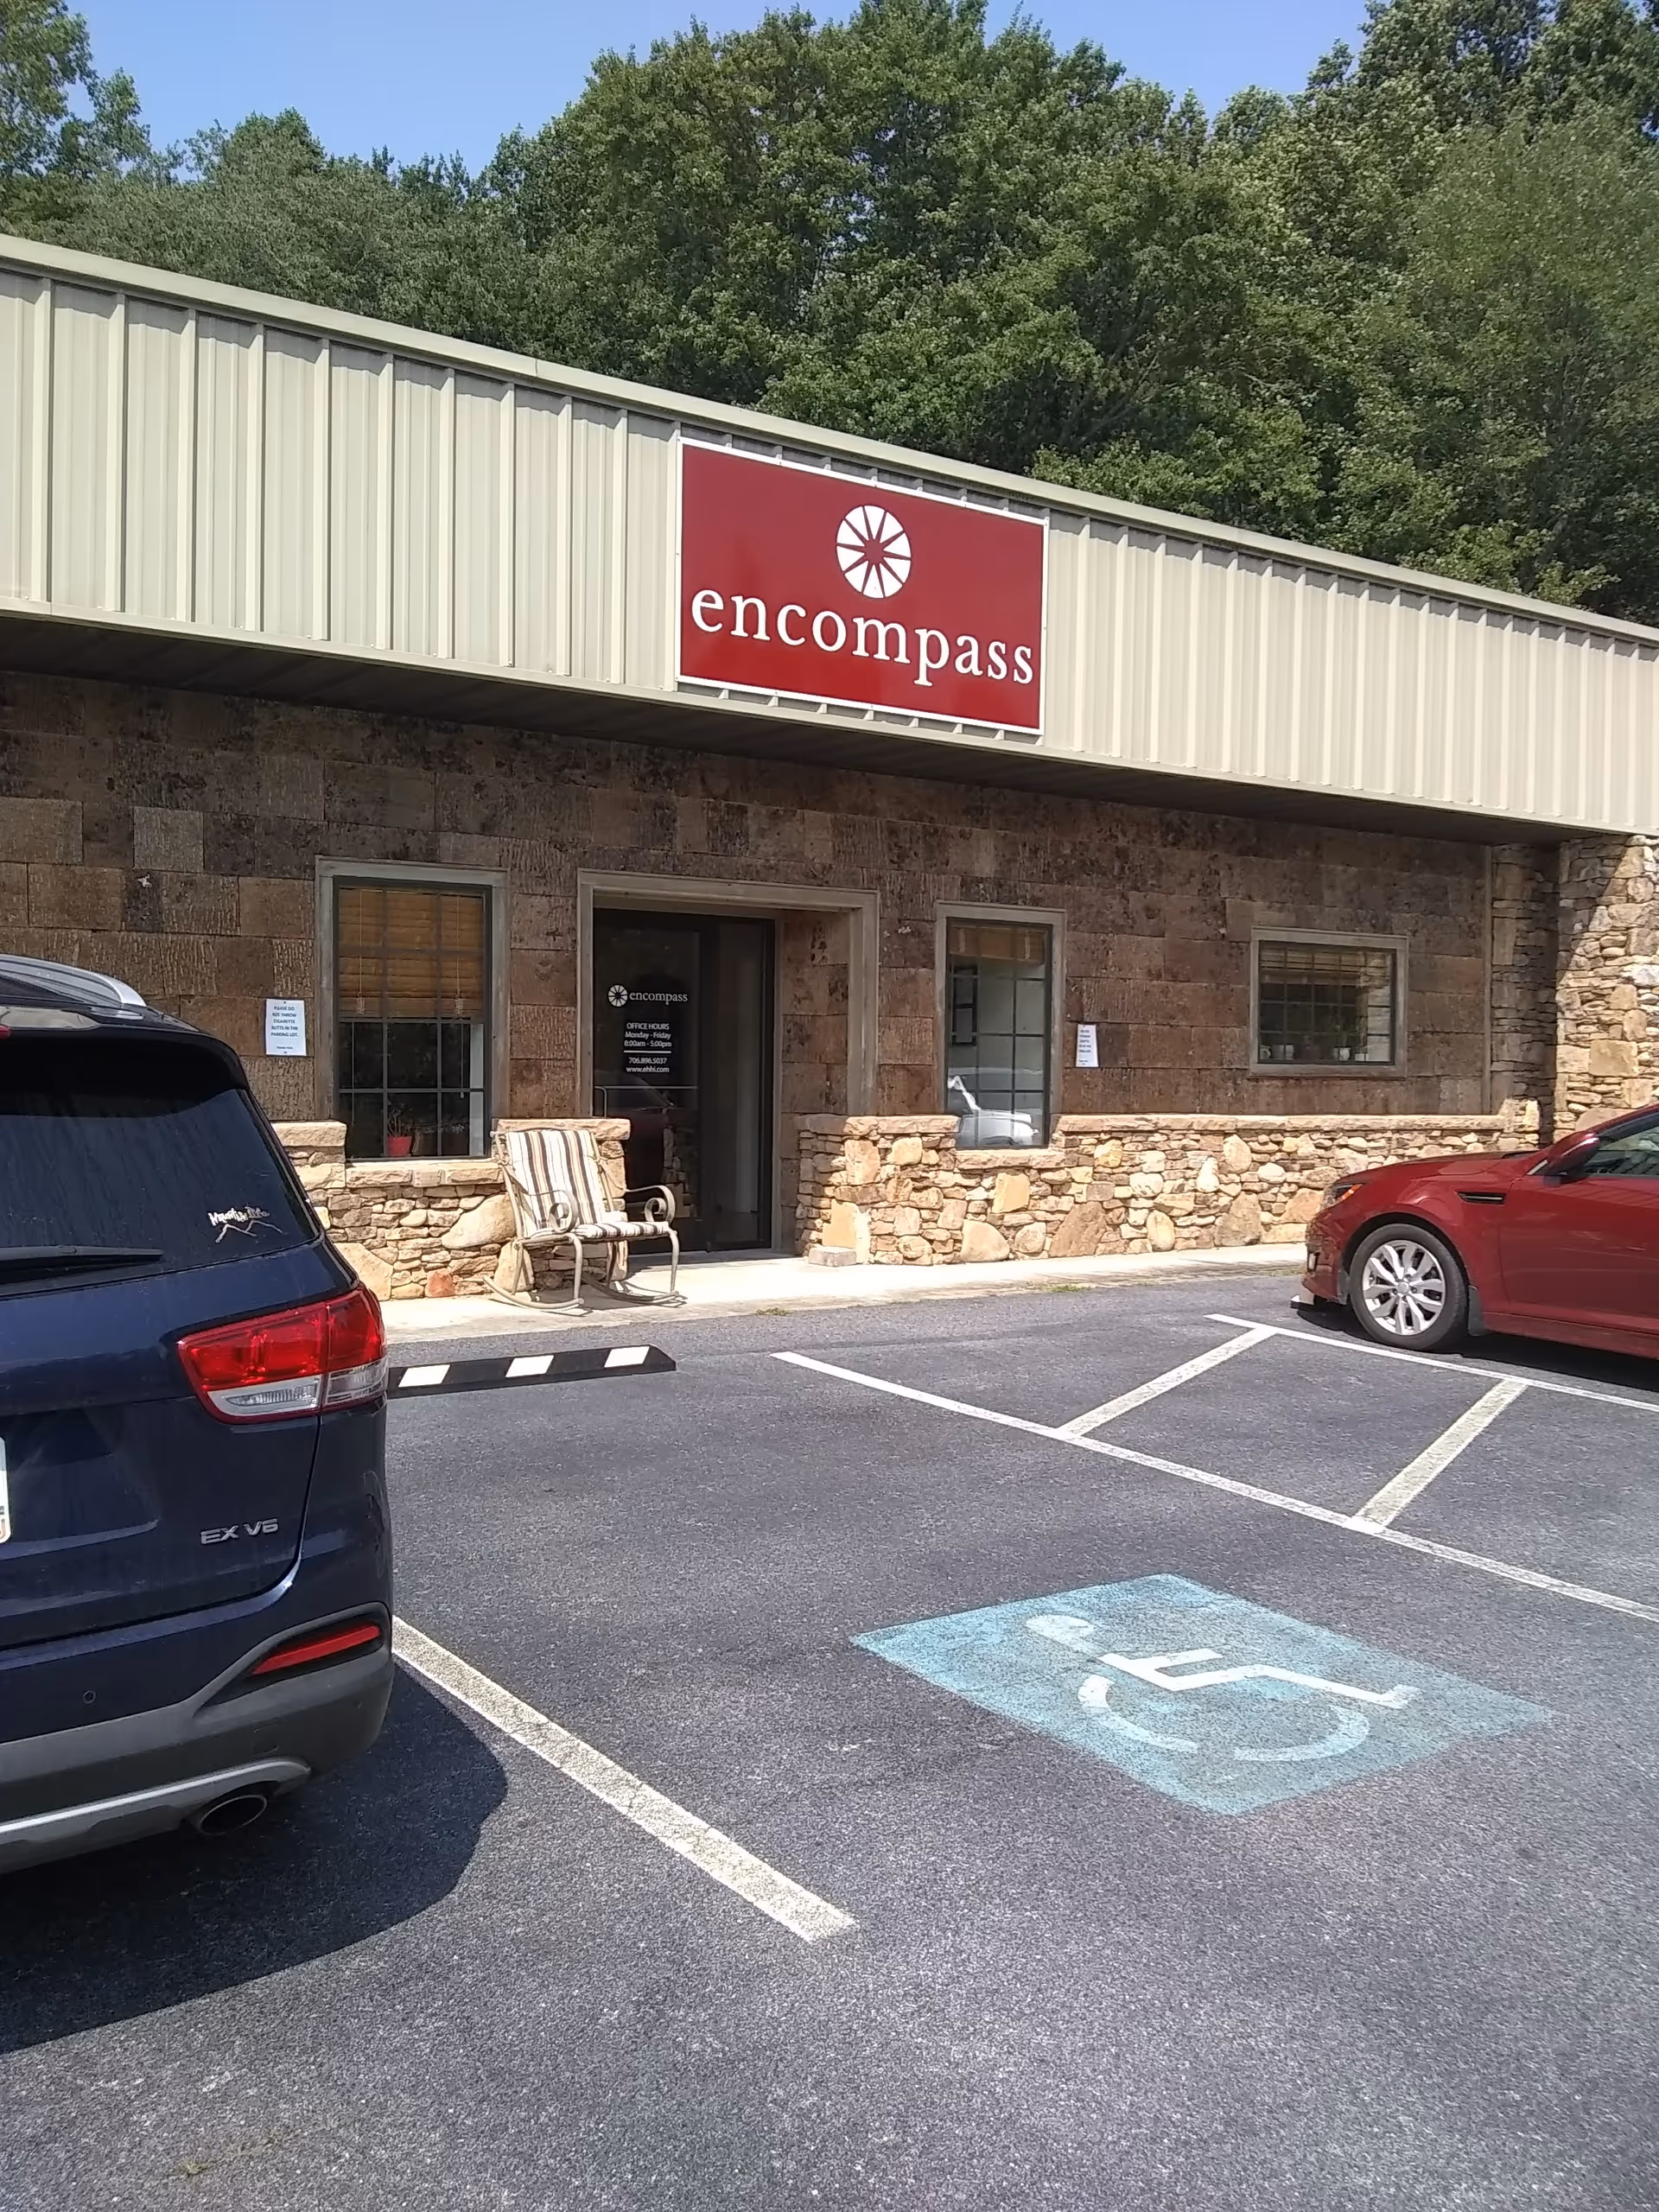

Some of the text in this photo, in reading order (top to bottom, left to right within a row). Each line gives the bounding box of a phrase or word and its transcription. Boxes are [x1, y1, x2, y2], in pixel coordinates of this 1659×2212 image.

[691, 588, 1034, 687] encompass
[629, 992, 689, 1005] encompass
[625, 1031, 649, 1039] Monday
[200, 1518, 279, 1545] EX V6
